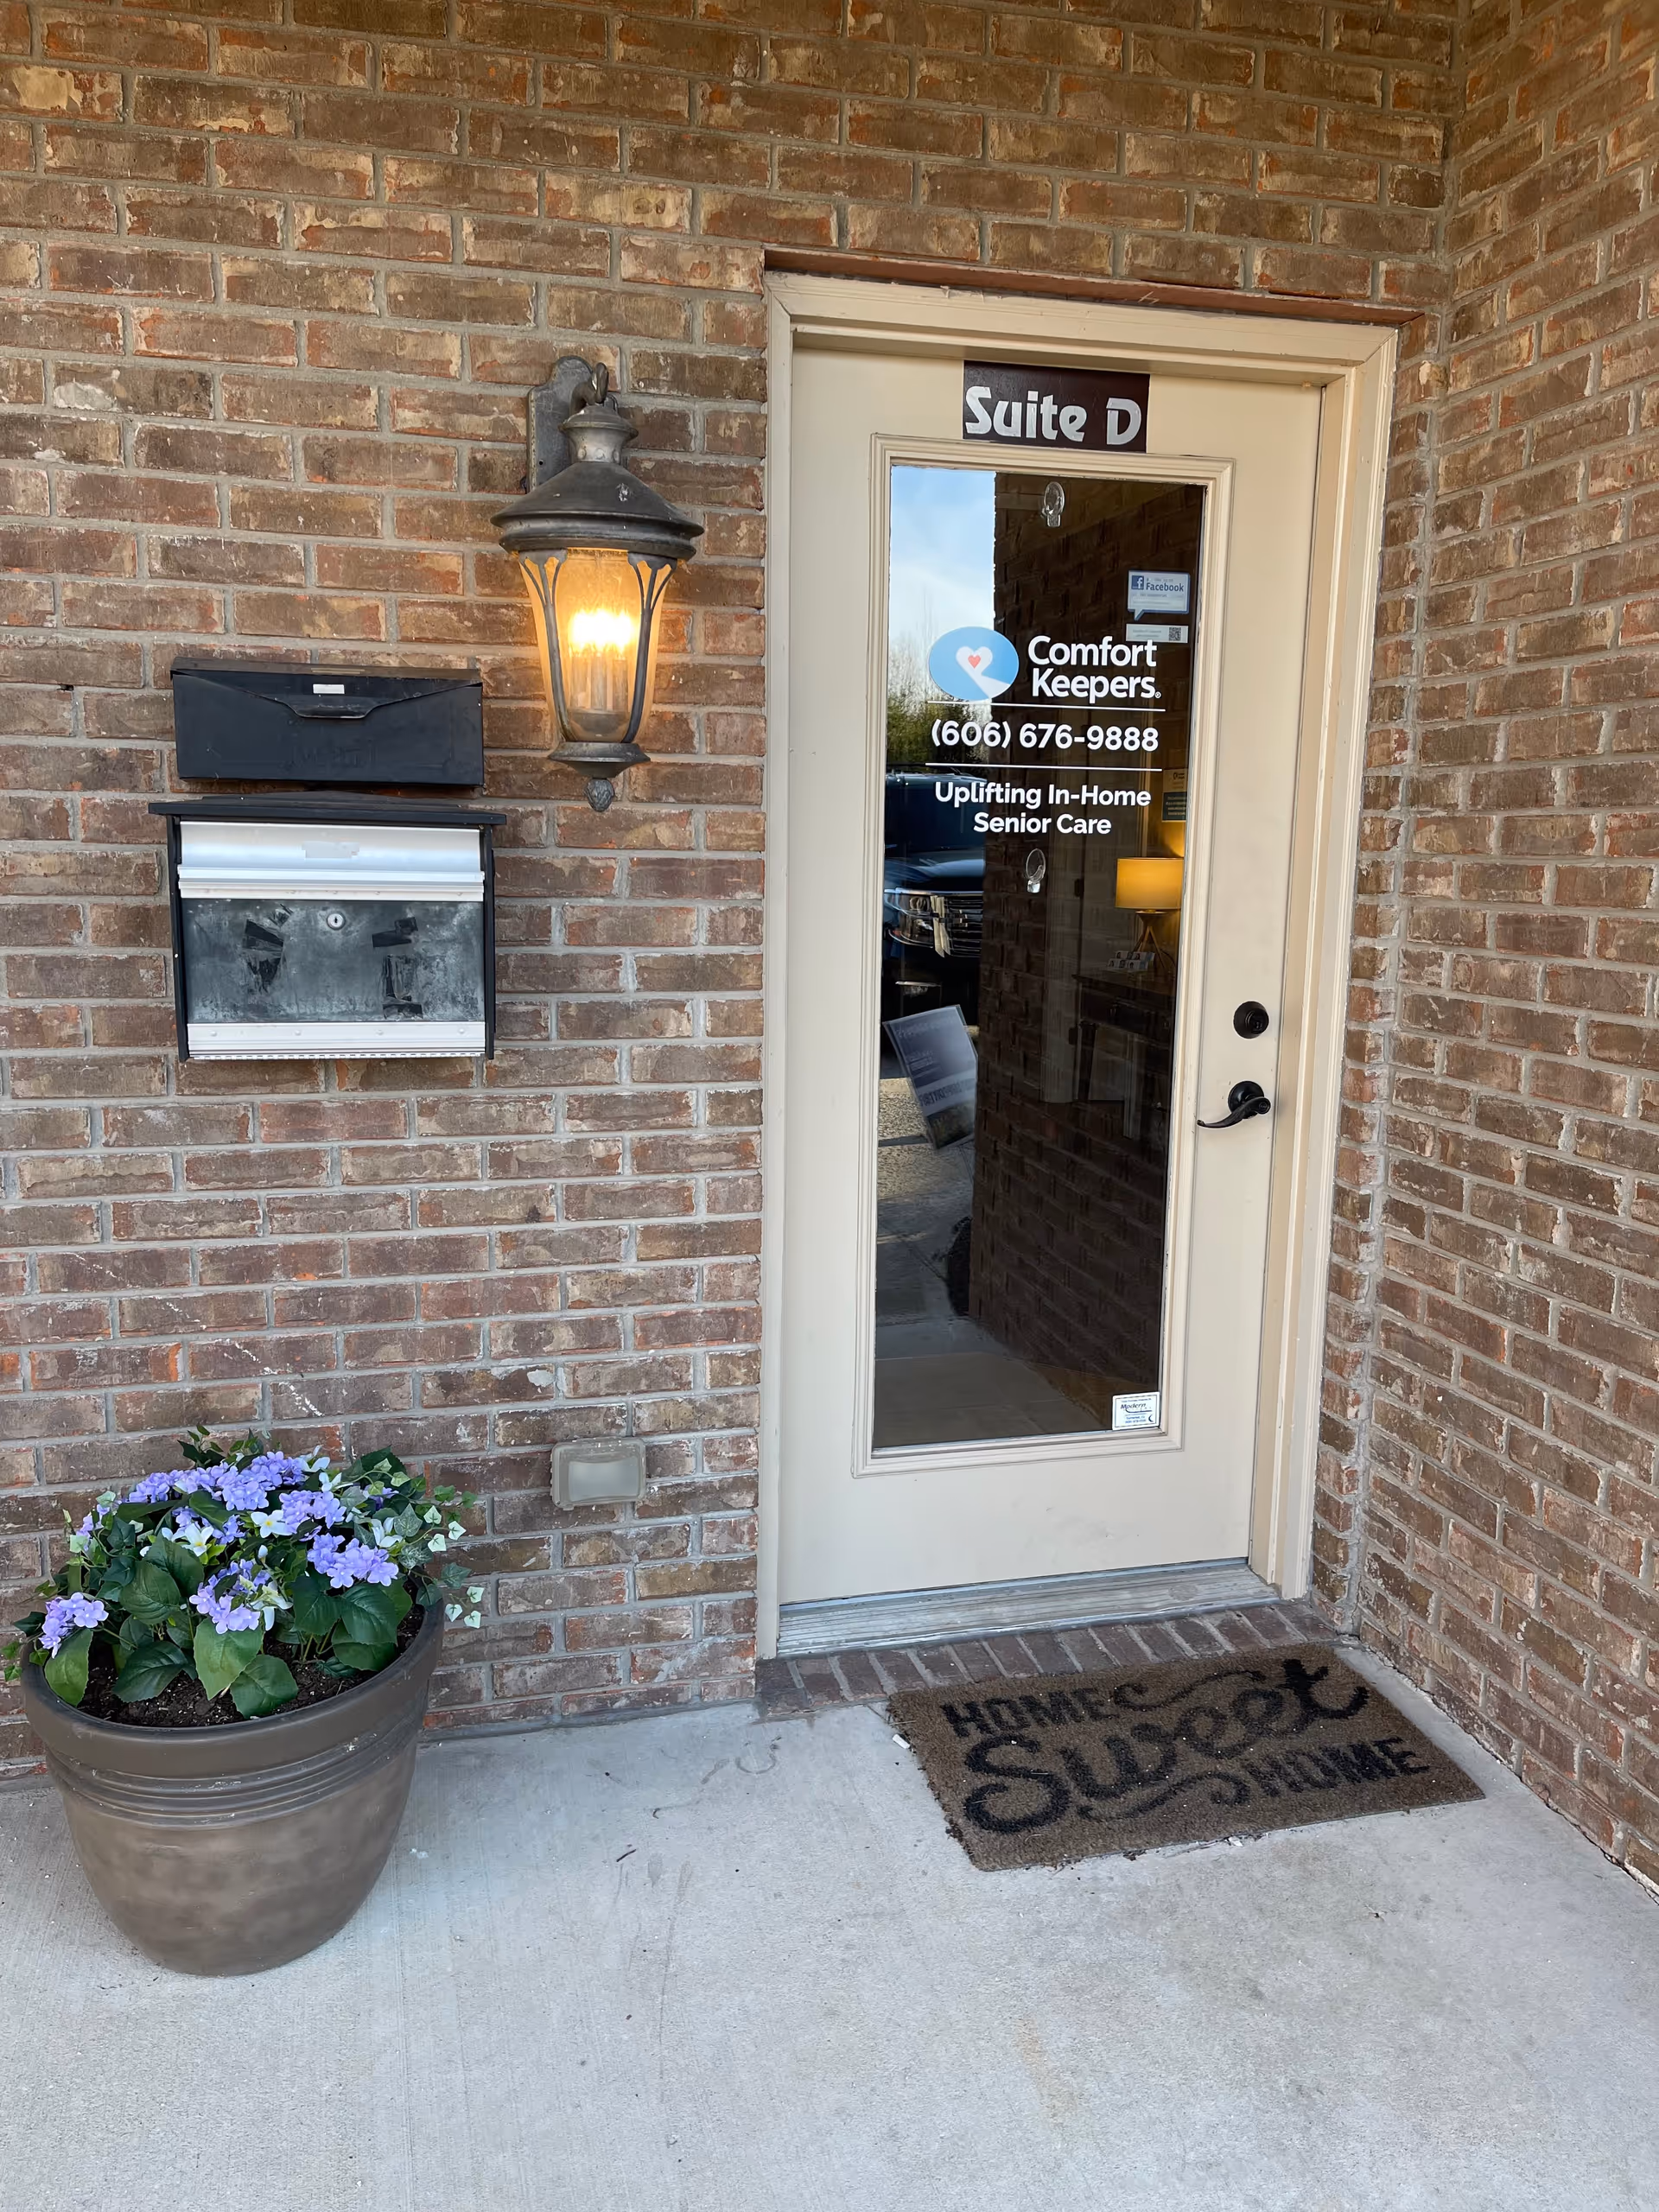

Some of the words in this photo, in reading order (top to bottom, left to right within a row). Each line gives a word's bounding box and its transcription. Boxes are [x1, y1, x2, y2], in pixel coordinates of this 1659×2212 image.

[965, 385, 1087, 442] Suite
[1106, 397, 1142, 445] D
[1146, 582, 1184, 592] Facebook
[1028, 635, 1157, 667] Comfort
[931, 719, 1011, 748] (606)
[1020, 722, 1159, 752] 676-9888
[935, 782, 1041, 810] Uplifting
[1048, 784, 1152, 807] In-Home
[973, 812, 1052, 834] Senior
[1056, 814, 1112, 835] Care
[942, 1687, 1115, 1738] HOME
[964, 1658, 1369, 1834] Sweet
[1243, 1737, 1431, 1798] HOME
